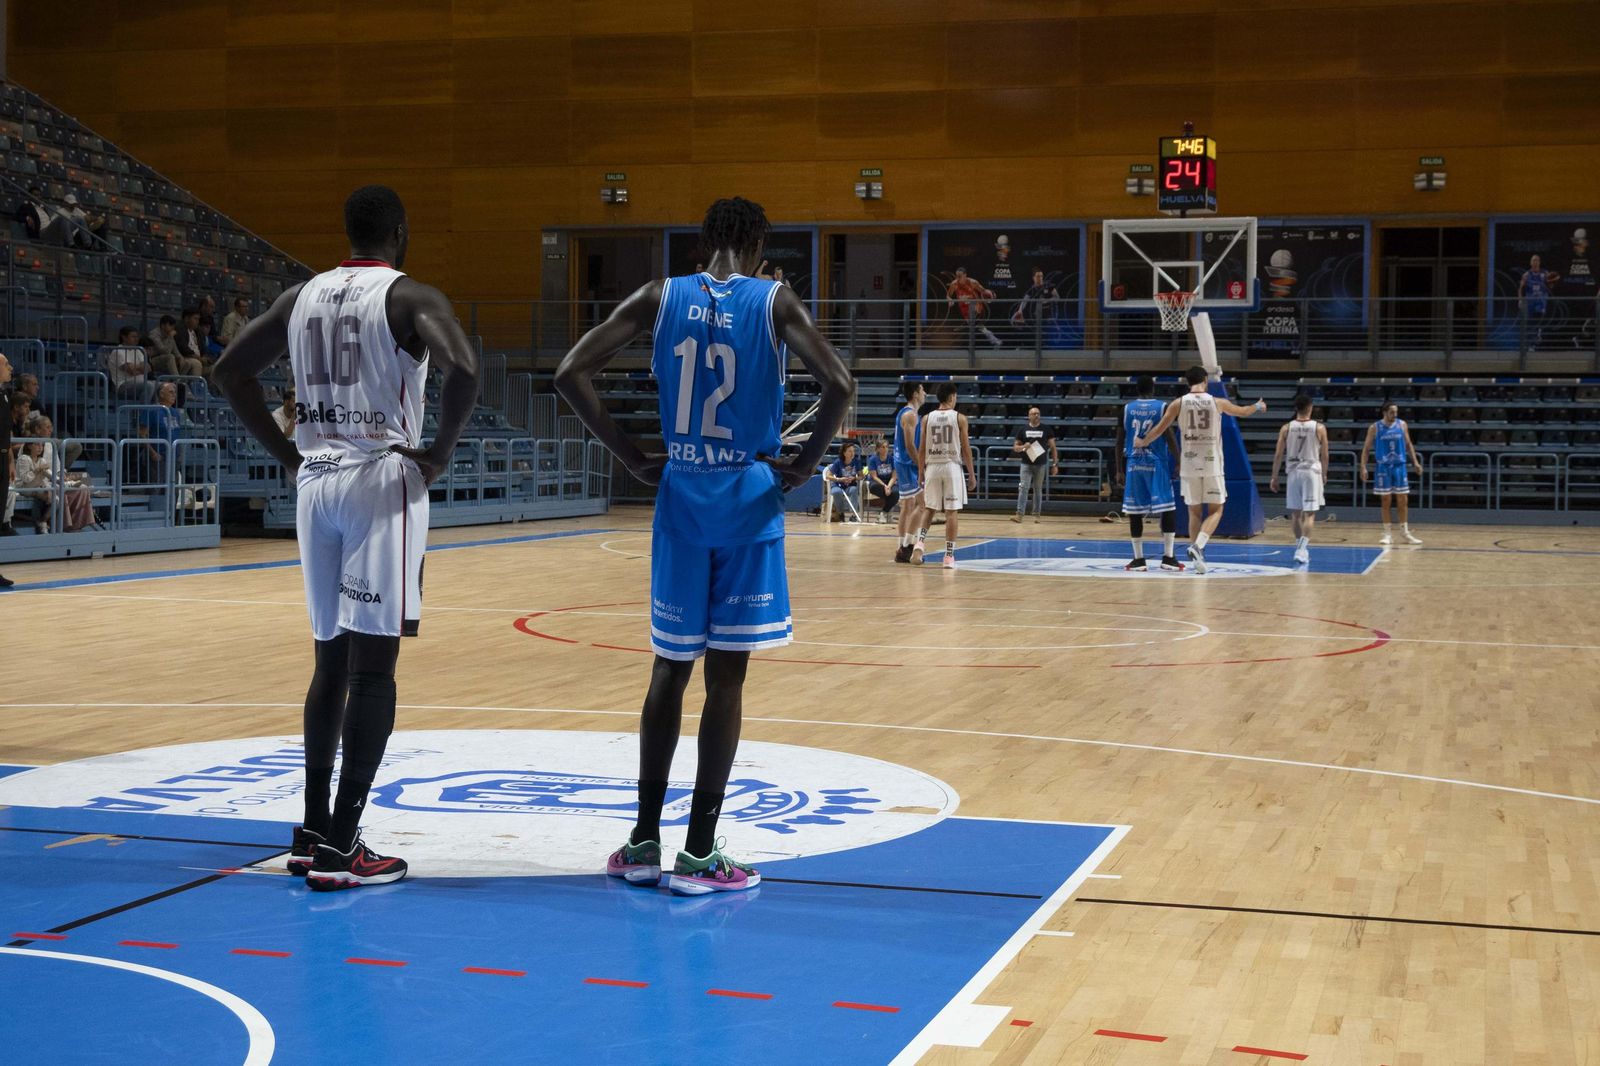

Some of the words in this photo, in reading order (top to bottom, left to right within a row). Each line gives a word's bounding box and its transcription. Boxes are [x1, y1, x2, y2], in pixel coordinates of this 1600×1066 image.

[1174, 139, 1204, 155] 7:46
[1165, 160, 1200, 190] 24
[688, 305, 734, 329] DIENE
[1266, 317, 1297, 326] COPA
[1270, 326, 1299, 334] REINA
[304, 315, 362, 387] 16
[674, 336, 736, 440] 12
[1188, 410, 1210, 429] 13
[931, 425, 953, 444] 50
[1297, 436, 1307, 452] 7
[343, 573, 369, 590] ORAIN
[477, 804, 597, 814] CUSTODIA
